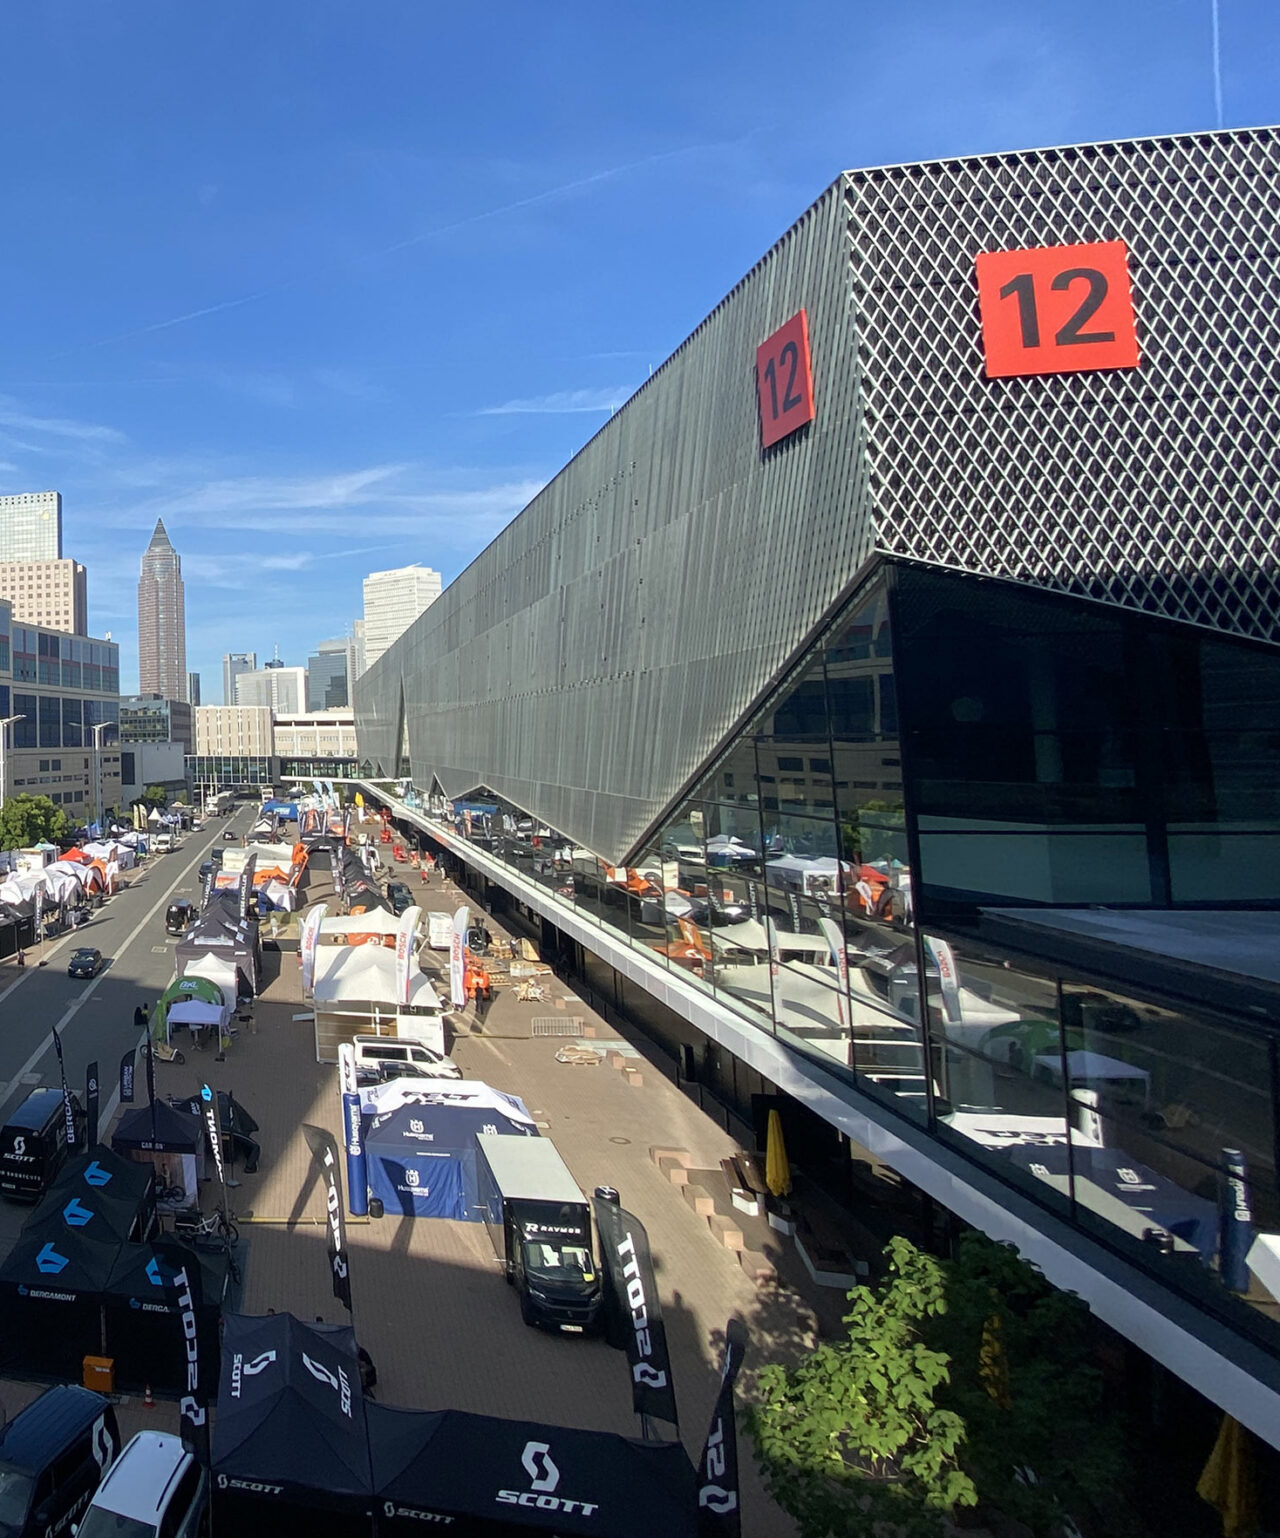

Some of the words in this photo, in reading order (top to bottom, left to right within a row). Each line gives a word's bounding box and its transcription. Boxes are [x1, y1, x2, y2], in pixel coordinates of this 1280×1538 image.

[998, 267, 1116, 349] 12
[763, 339, 803, 421] 12
[305, 927, 315, 951] BOSCH
[397, 931, 407, 959] BOSCH
[453, 932, 461, 961] BOSCH
[3, 1152, 36, 1163] SCOTT
[30, 1289, 76, 1302] BERGAMONT
[231, 1353, 243, 1399] SCOTT
[338, 1365, 352, 1419] SCOTT
[229, 1479, 284, 1495] SCOTT
[396, 1507, 455, 1525] SCOTT
[495, 1489, 599, 1517] SCOTT
